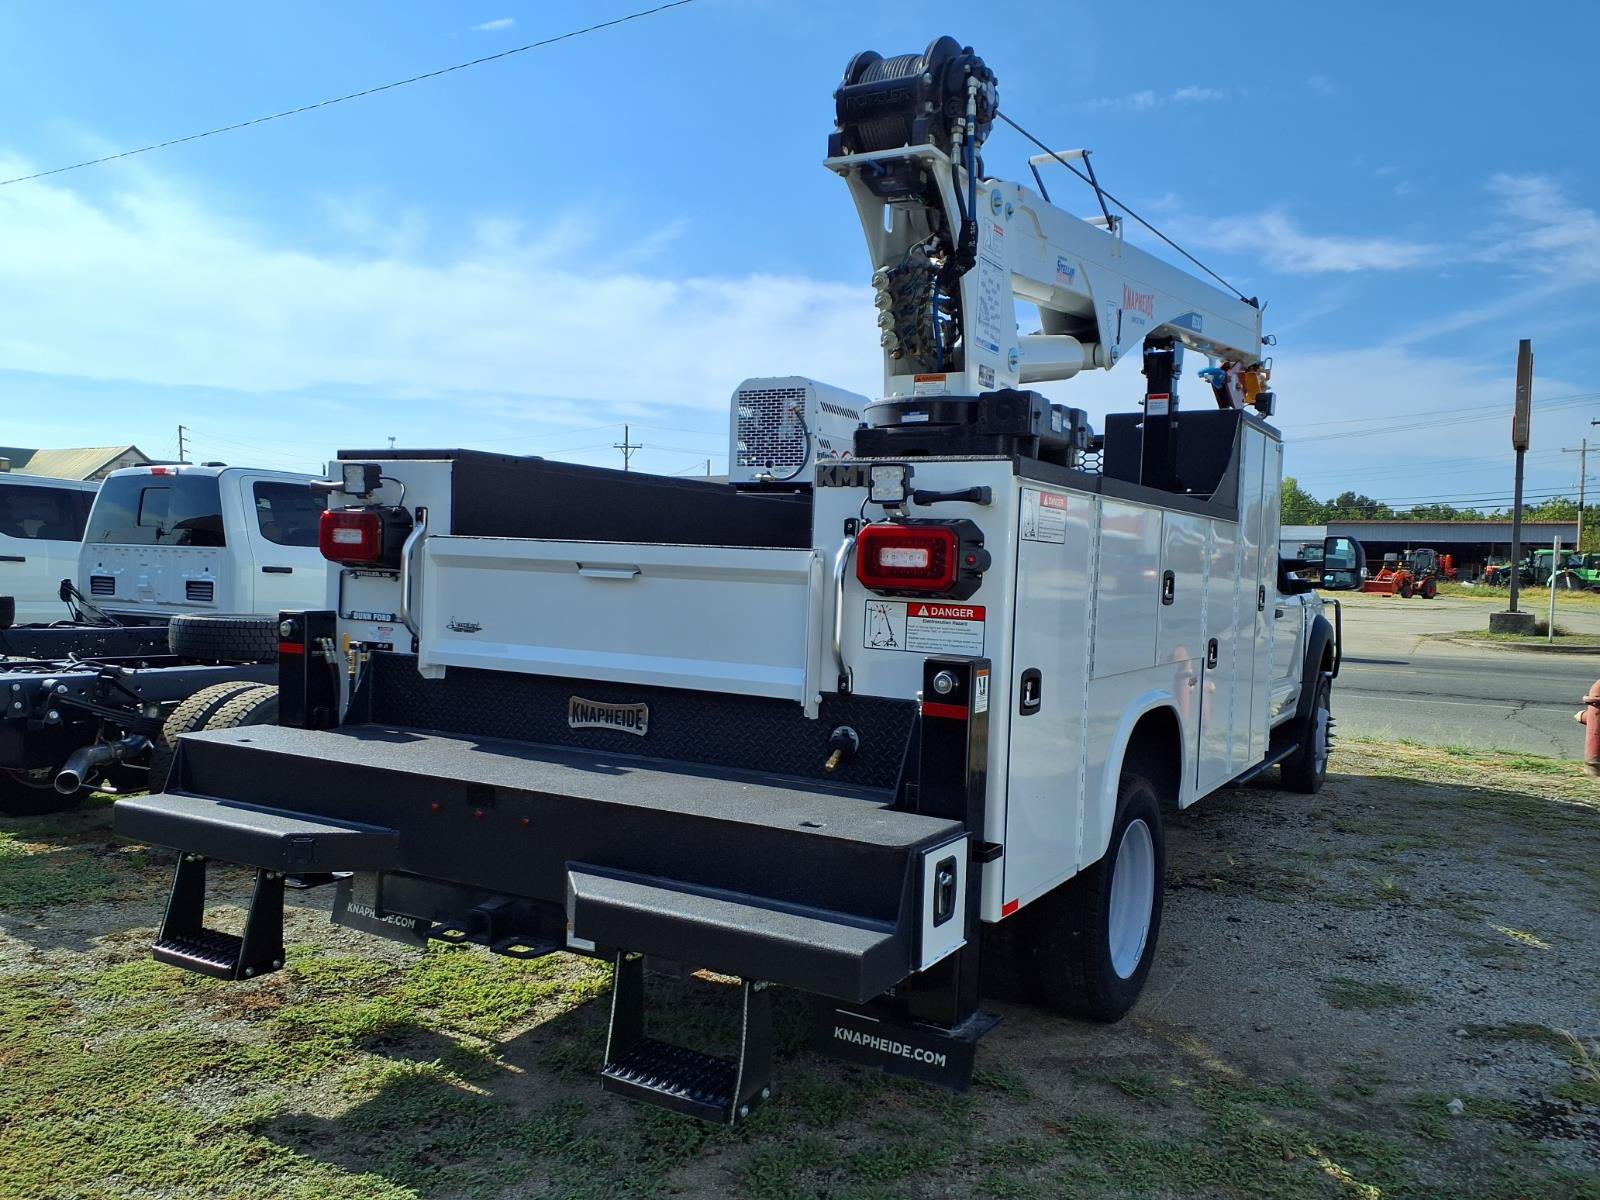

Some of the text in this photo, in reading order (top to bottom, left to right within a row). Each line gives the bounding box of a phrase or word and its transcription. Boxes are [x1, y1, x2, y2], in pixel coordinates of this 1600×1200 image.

[1122, 283, 1155, 320] KNAPHEIDE
[373, 614, 391, 622] FORD
[931, 607, 974, 618] DANGER
[572, 701, 643, 731] KNAPHEIDE
[834, 1026, 947, 1067] KNAPHEIDE.COM
